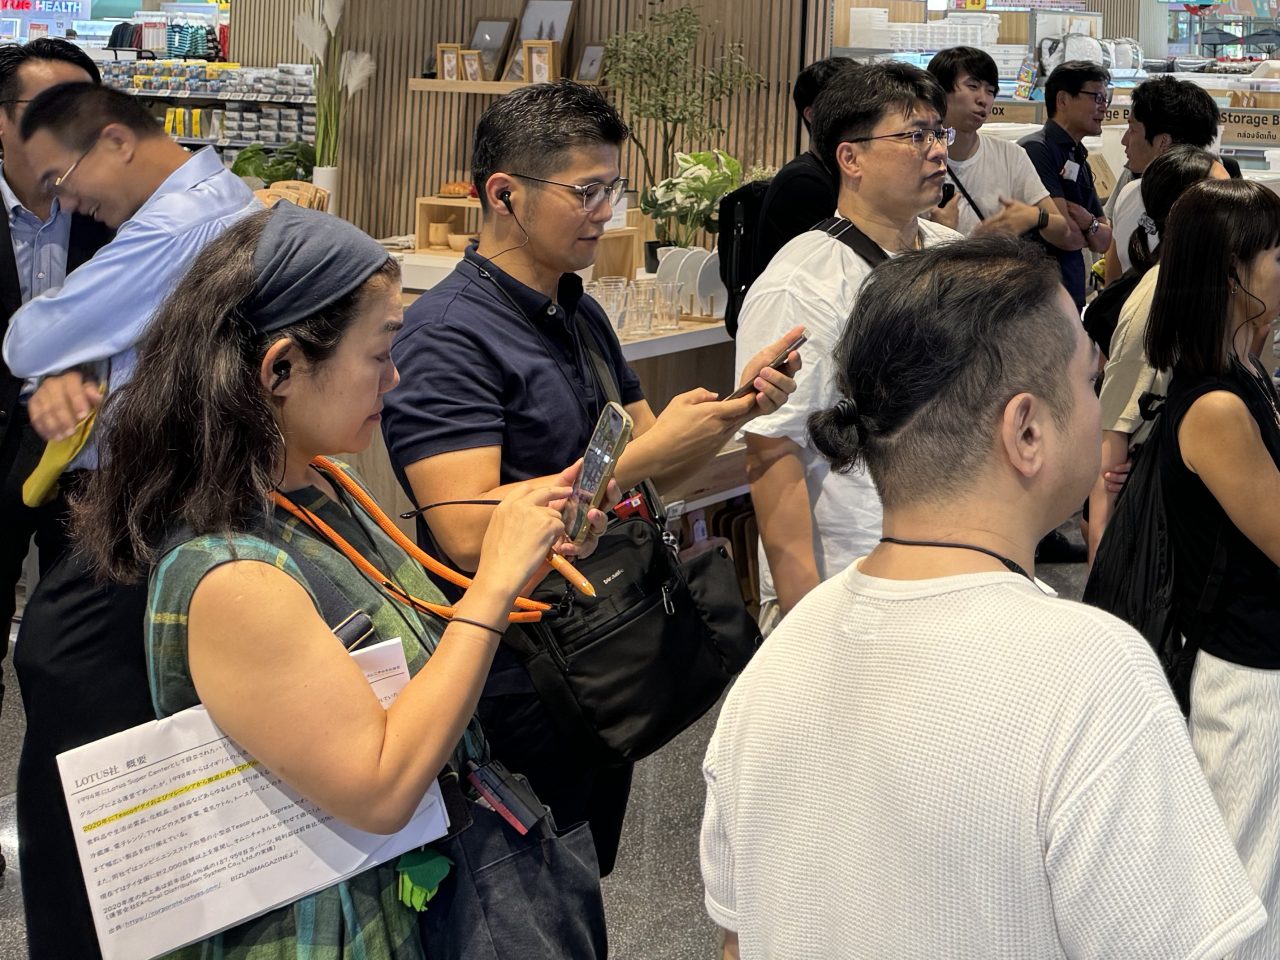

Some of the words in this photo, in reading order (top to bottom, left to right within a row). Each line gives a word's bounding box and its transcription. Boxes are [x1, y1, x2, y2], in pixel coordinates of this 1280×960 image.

[36, 0, 82, 13] HEALTH
[1221, 111, 1268, 128] Storage
[73, 763, 120, 789] LOTUS社
